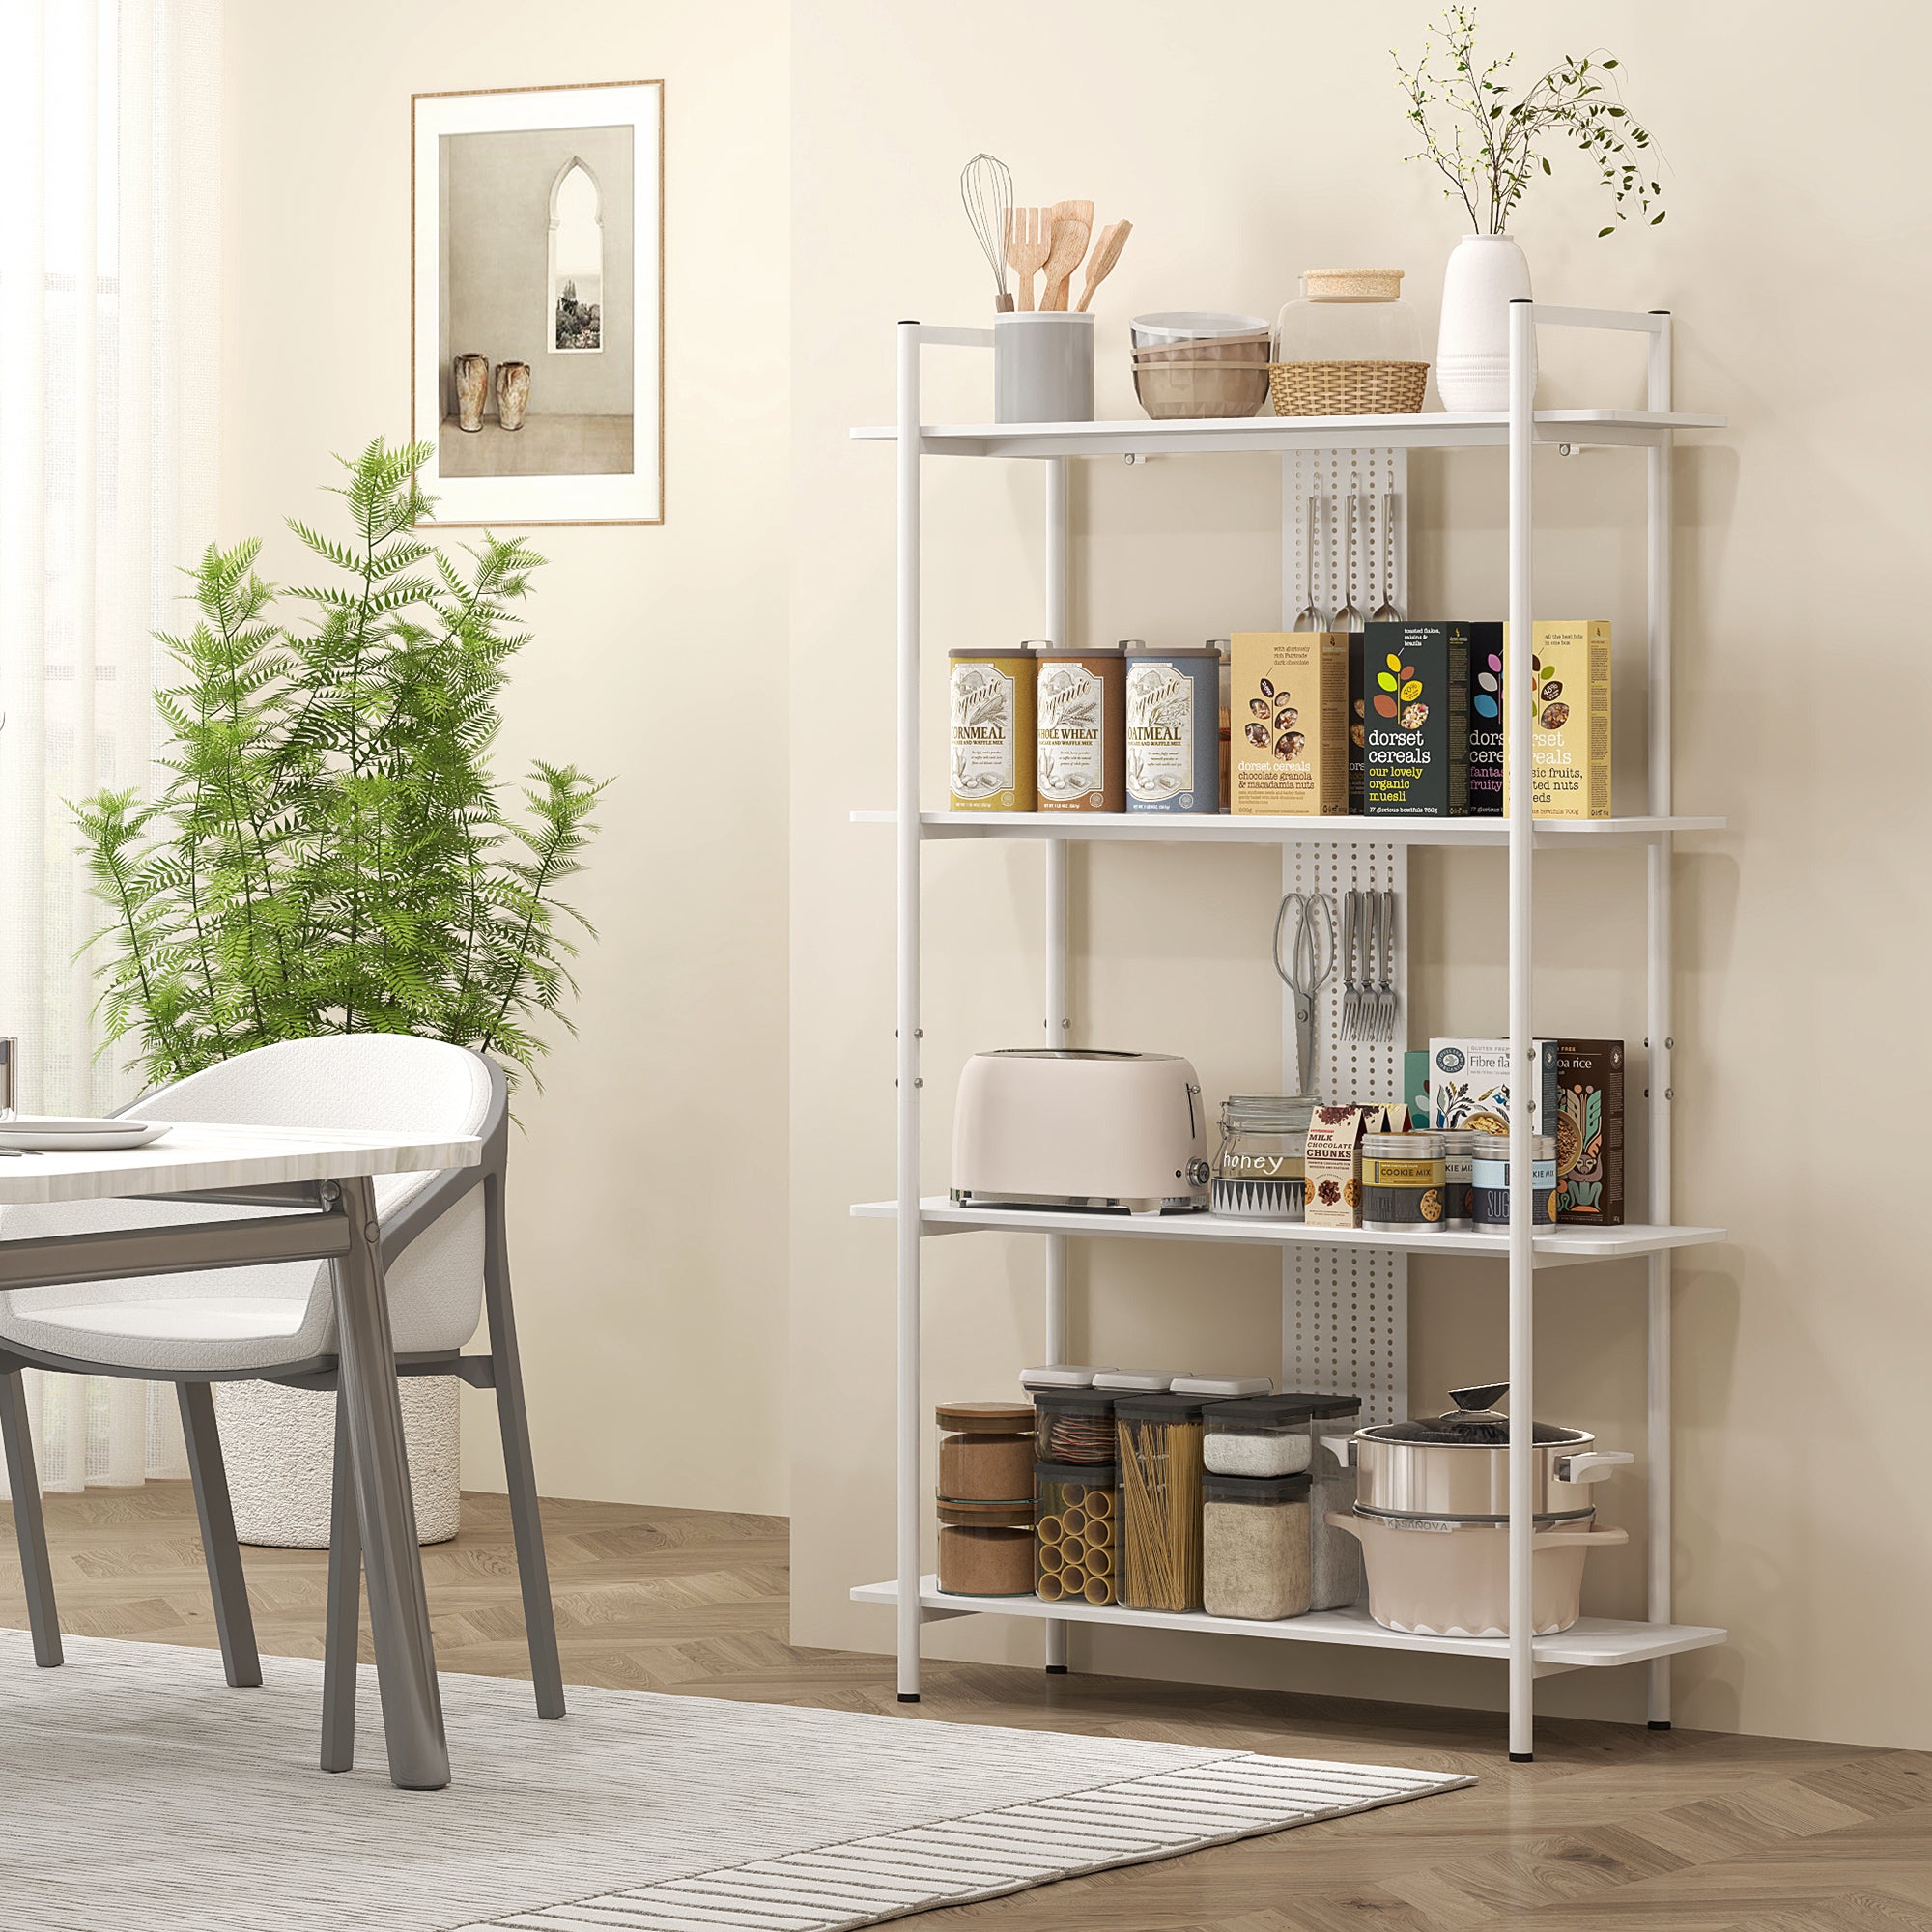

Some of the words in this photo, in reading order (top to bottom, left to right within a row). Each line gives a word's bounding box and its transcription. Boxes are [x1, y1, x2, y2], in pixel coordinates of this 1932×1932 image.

[1262, 681, 1272, 696] new
[1061, 729, 1098, 740] WHEAT
[1128, 727, 1181, 741] OATMEAL
[1368, 730, 1425, 746] dorset
[1368, 748, 1432, 764] cereals
[1469, 750, 1504, 763] cere
[1238, 761, 1271, 771] dorset
[1273, 761, 1311, 771] cereals
[1238, 772, 1278, 781] chocolate
[1280, 772, 1312, 781] granola
[1369, 768, 1389, 777] our
[1390, 767, 1423, 779] lovely
[1548, 768, 1583, 780] fruits,
[1248, 781, 1295, 789] macadamia
[1369, 779, 1410, 791] organic
[1469, 780, 1502, 792] fruity
[1533, 781, 1550, 791] ted
[1553, 781, 1579, 791] nuts
[1369, 791, 1406, 802] muesli
[1533, 792, 1551, 803] eds
[1470, 1055, 1495, 1067] Fibre
[1498, 1055, 1510, 1067] fla
[1573, 1057, 1592, 1068] rice
[1307, 1149, 1351, 1158] CHUNKS
[1223, 1150, 1284, 1175] honey
[1488, 1191, 1510, 1218] SUG
[1388, 1519, 1448, 1531] KASANOVA
